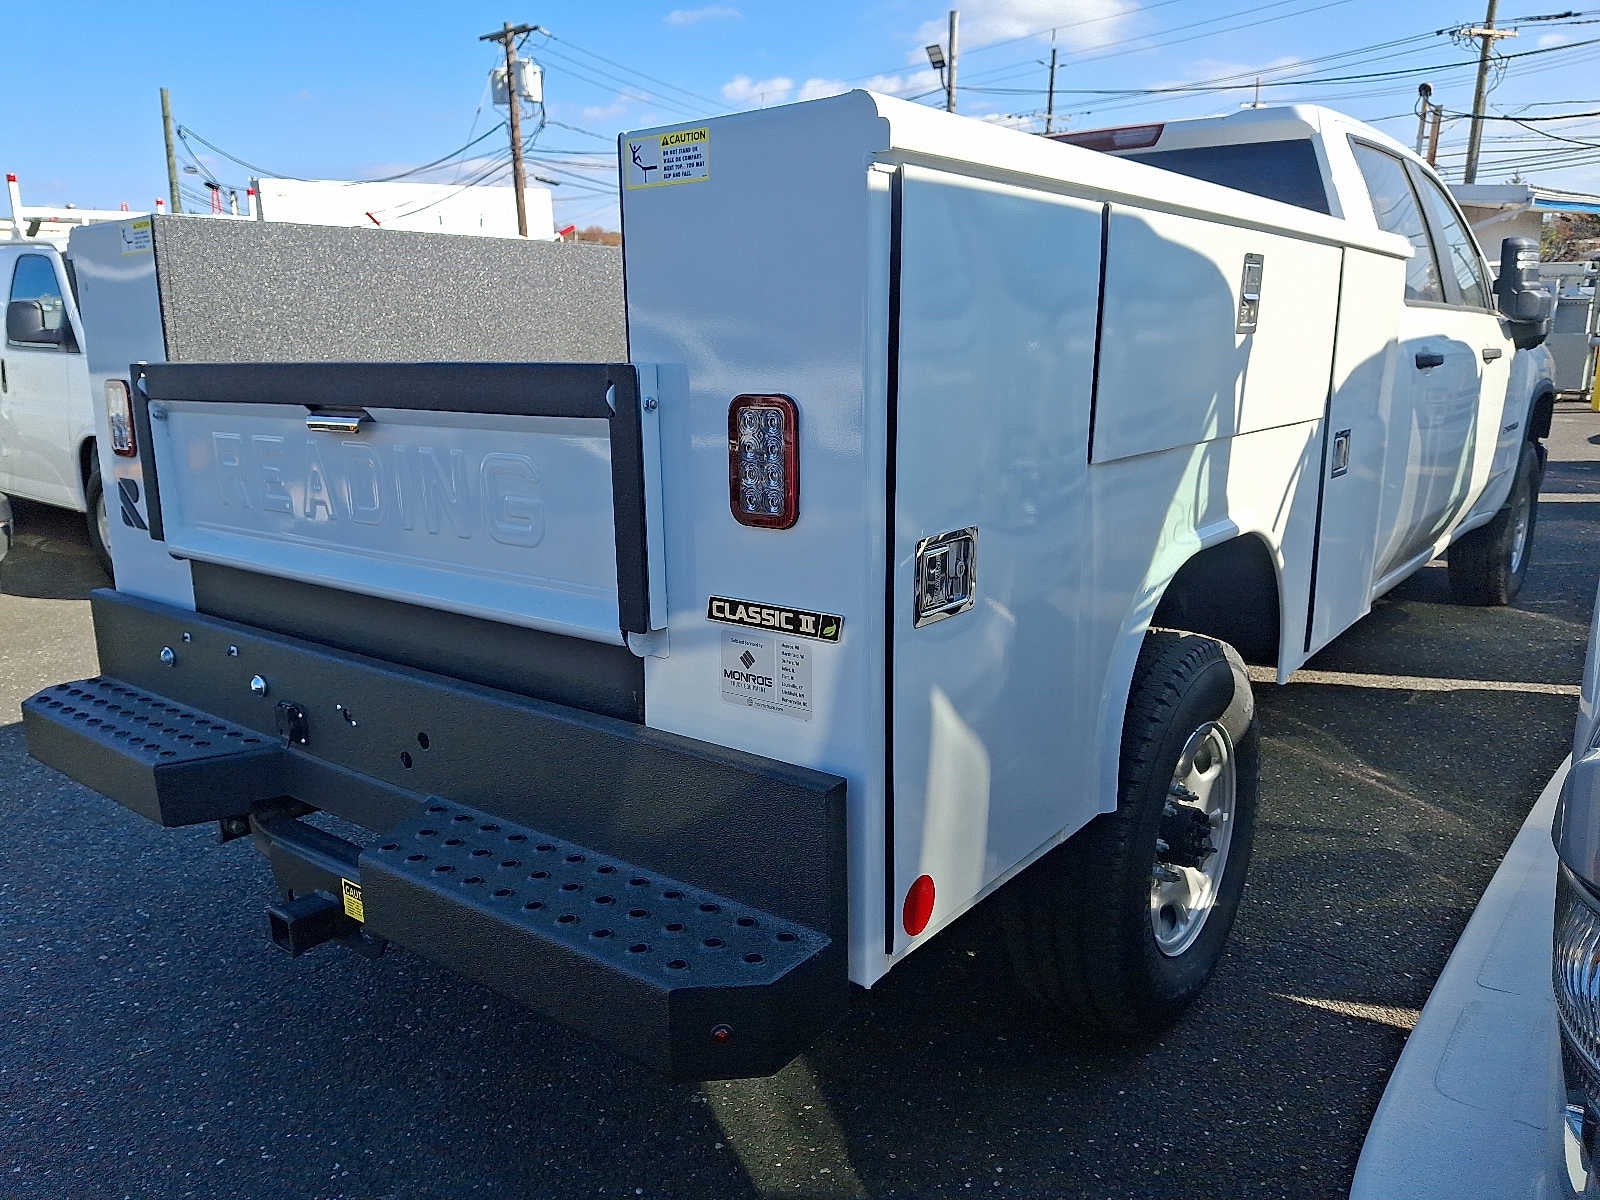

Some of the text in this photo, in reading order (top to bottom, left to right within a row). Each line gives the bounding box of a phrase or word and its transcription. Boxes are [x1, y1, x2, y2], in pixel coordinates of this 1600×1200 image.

[669, 130, 706, 144] CAUTION
[212, 431, 546, 549] READING
[712, 601, 816, 634] CLASSIC II
[723, 669, 773, 688] MONROE
